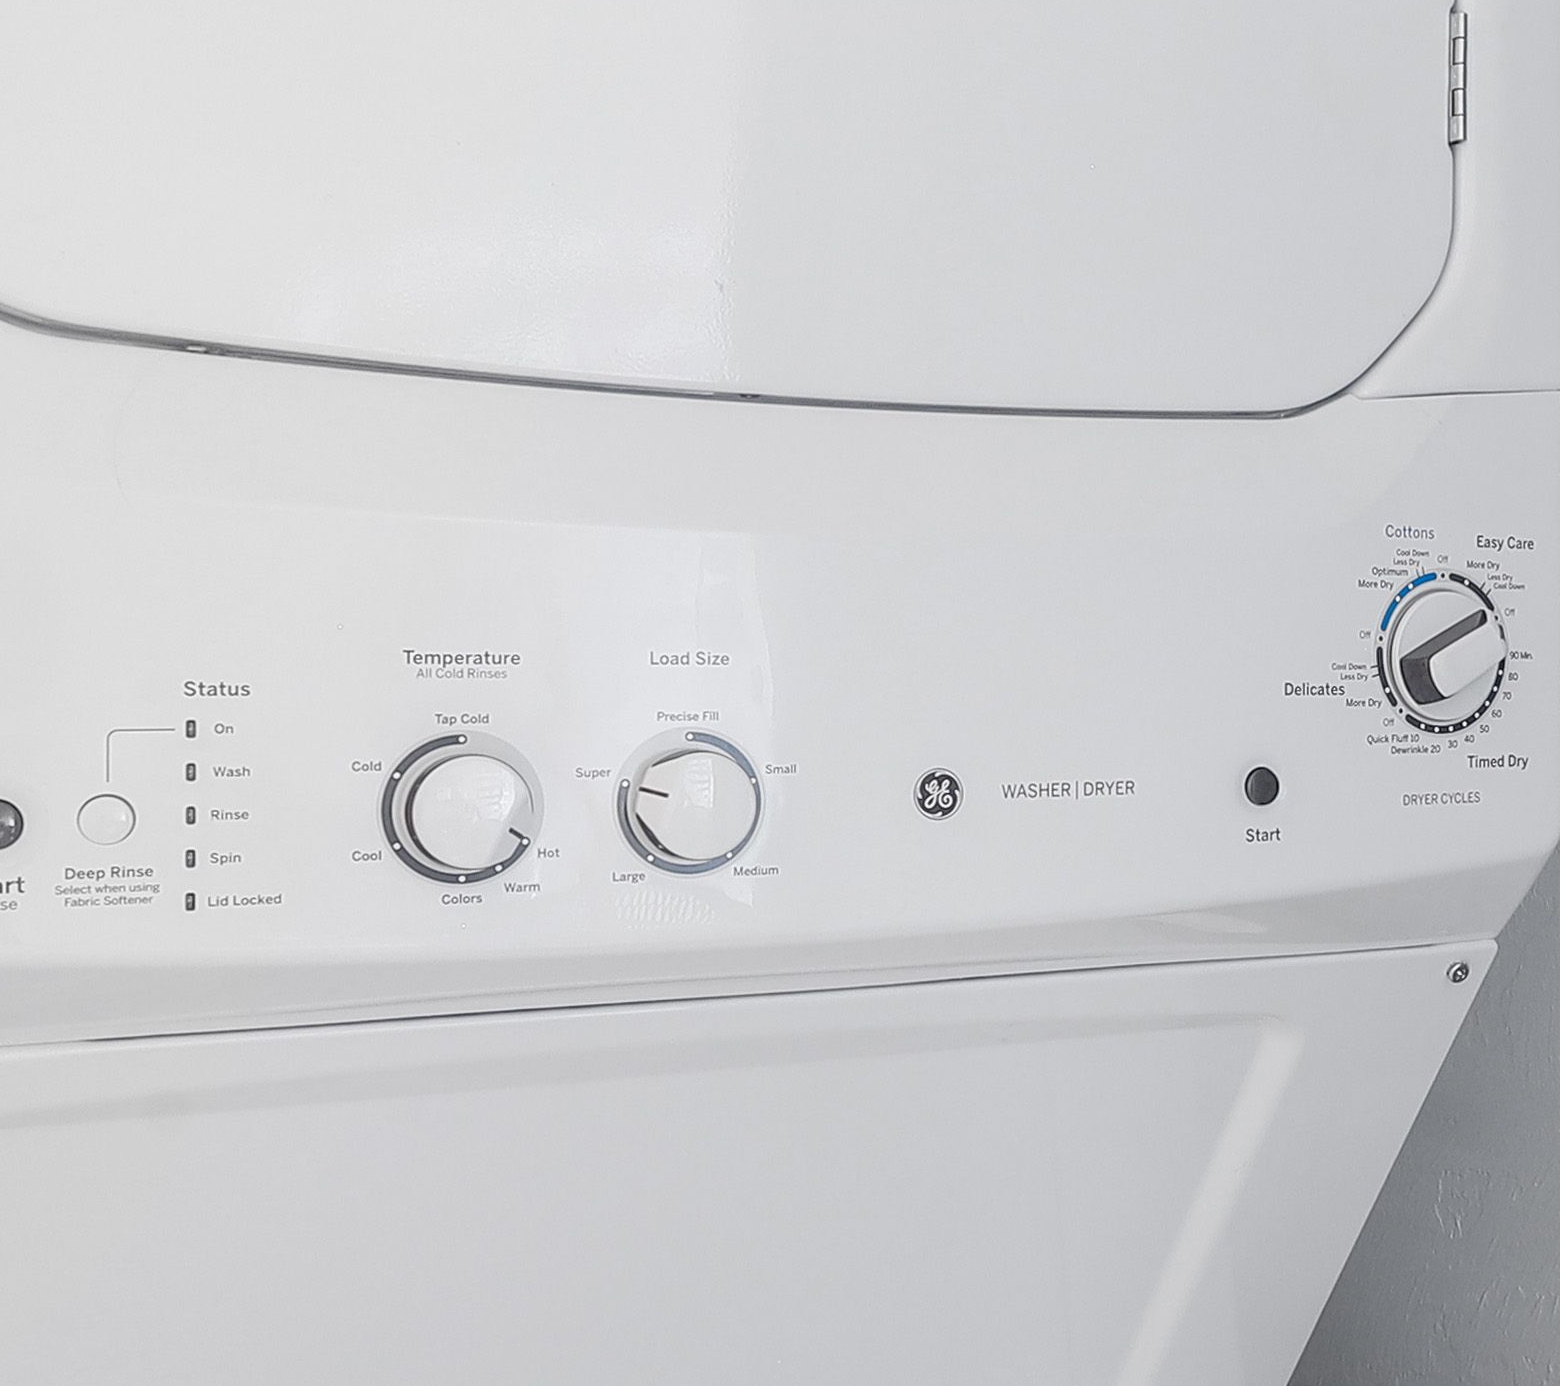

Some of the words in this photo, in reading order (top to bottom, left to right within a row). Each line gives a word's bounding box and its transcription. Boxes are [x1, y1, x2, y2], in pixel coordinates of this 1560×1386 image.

[1386, 525, 1435, 539] Cottons
[1477, 535, 1505, 551] Easy
[1507, 536, 1534, 550] Care
[1467, 560, 1485, 568] More
[1487, 561, 1500, 571] Dry
[1372, 567, 1408, 577] Optimum
[1358, 580, 1377, 588] More
[1379, 580, 1393, 590] Dry
[403, 651, 521, 668] Temperature
[650, 652, 690, 666] Load
[696, 652, 729, 666] Size
[416, 668, 432, 679] All
[435, 668, 465, 679] Cold
[469, 668, 507, 679] Rinses
[183, 681, 250, 698] Status
[1284, 683, 1345, 696] Delicates
[1502, 692, 1512, 700] 70
[1346, 698, 1366, 708] More
[1368, 699, 1382, 708] Dry
[435, 714, 458, 727] Tap
[461, 713, 490, 725] Cold
[657, 711, 697, 722] Precise
[703, 711, 719, 721] Fill
[1492, 710, 1502, 718] 60
[214, 723, 234, 734] On
[1480, 725, 1489, 733] 50
[1367, 735, 1389, 745] Quick
[1392, 735, 1409, 743] Fluff
[1411, 734, 1419, 742] 10
[1448, 740, 1458, 748] 30
[1464, 735, 1475, 743] 40
[1391, 745, 1428, 754] Dewrinkle
[1431, 745, 1440, 753] 20
[352, 761, 381, 772] Cold
[1468, 755, 1505, 769] Timed
[1508, 756, 1529, 769] Dry
[213, 766, 250, 778] Wash
[575, 767, 610, 780] Super
[765, 763, 796, 774] Small
[1002, 782, 1071, 799] WASHER
[1083, 780, 1135, 796] DRYER
[1403, 794, 1438, 806] DRYER
[1441, 792, 1480, 804] CYCLES
[211, 809, 249, 821] Rinse
[1245, 826, 1281, 843] Start
[210, 852, 241, 865] Spin
[352, 851, 381, 862] Cool
[537, 847, 560, 859] Hot
[65, 868, 105, 881] Deep
[111, 866, 154, 878] Rinse
[733, 865, 779, 877] Medium
[612, 871, 646, 884] Large
[55, 885, 91, 895] Select
[95, 884, 126, 893] when
[129, 883, 160, 893] using
[504, 882, 540, 893] Warm
[65, 897, 100, 907] Fabric
[104, 896, 152, 905] Softener
[207, 895, 229, 907] Lid
[234, 894, 282, 906] Locked
[442, 893, 483, 905] Colors
